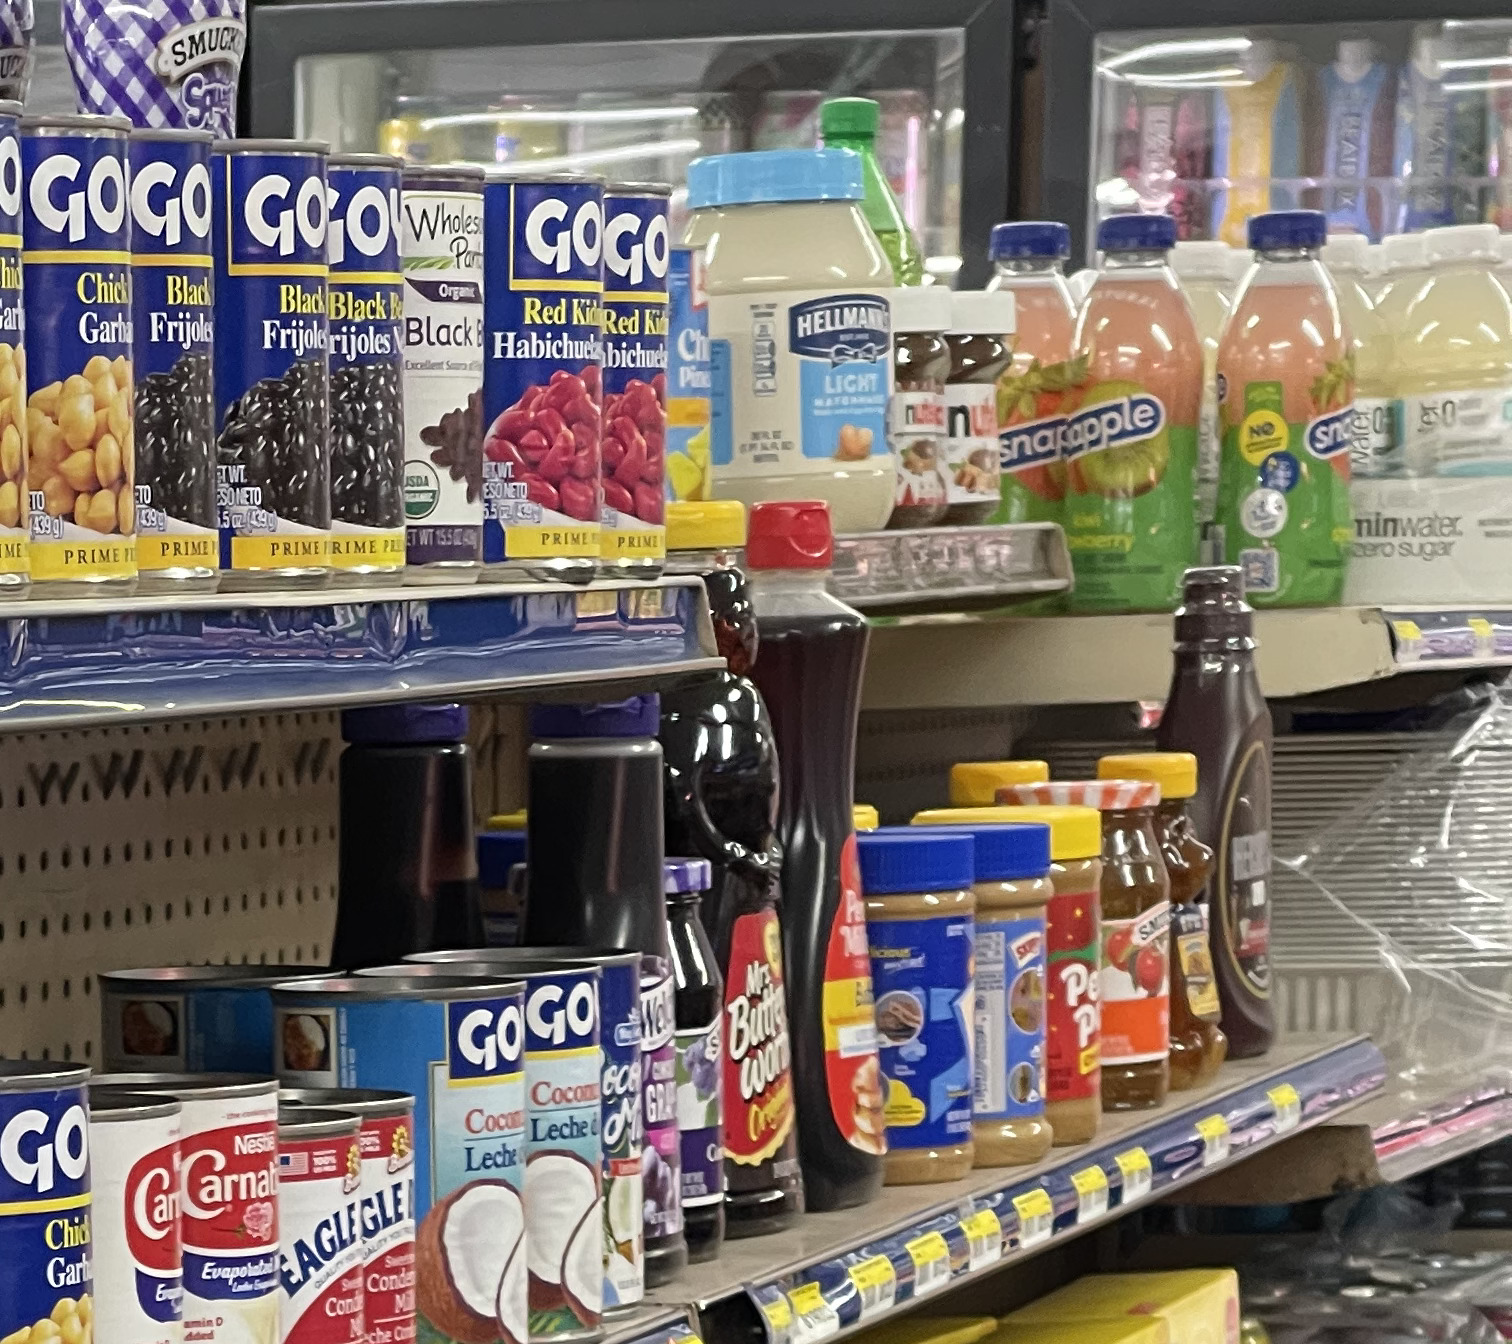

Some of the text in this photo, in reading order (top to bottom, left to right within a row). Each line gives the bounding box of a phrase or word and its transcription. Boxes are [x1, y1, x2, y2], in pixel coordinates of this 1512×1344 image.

[167, 276, 211, 305] Black
[280, 284, 325, 314] Black
[330, 292, 386, 320] Black
[524, 298, 567, 325] Red
[406, 317, 470, 348] Black
[604, 310, 640, 334] Red
[825, 374, 878, 394] LIGHT
[271, 540, 320, 556] PRIME
[541, 531, 589, 546] PRIME
[1352, 541, 1455, 561] zero sugar
[64, 546, 122, 566] PRIME
[531, 1116, 586, 1142] Leche
[464, 1146, 516, 1173] Leche
